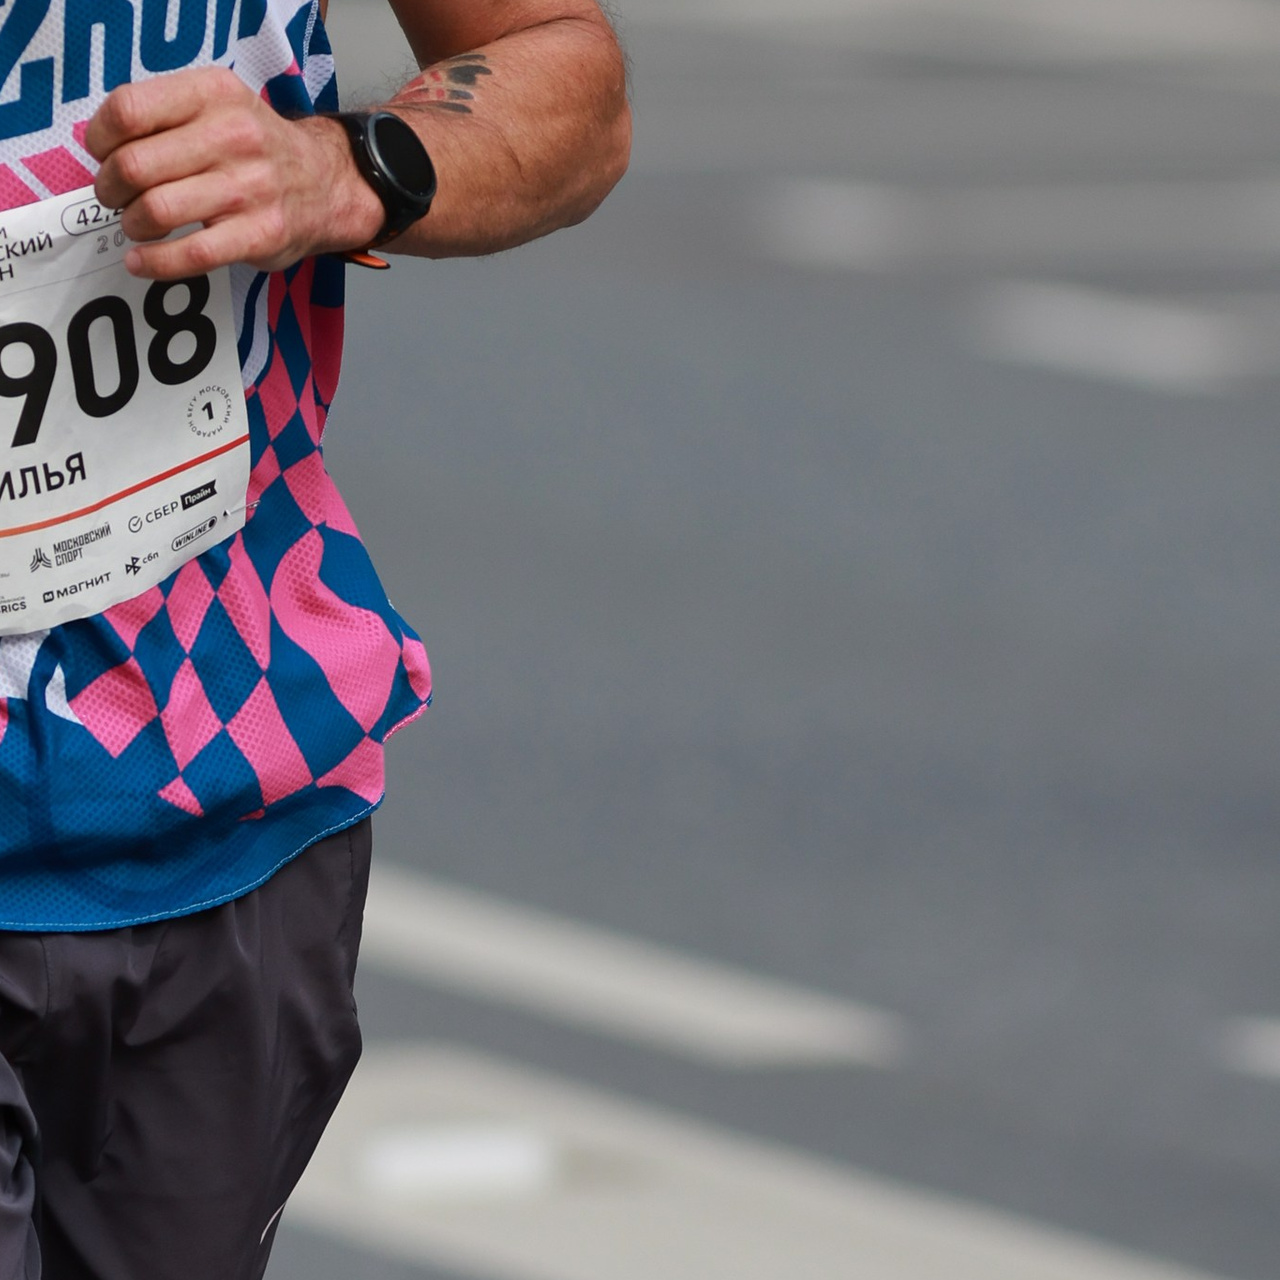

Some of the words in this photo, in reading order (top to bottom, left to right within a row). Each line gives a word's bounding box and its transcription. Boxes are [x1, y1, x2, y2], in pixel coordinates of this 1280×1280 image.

[201, 401, 214, 420] 1
[145, 500, 179, 523] СБЕР
[184, 486, 212, 505] Прайм
[52, 521, 112, 555] МОСКОВСКИЙ
[174, 523, 207, 548] WINLINE
[54, 547, 84, 567] СПОРТ
[142, 551, 159, 564] сбп
